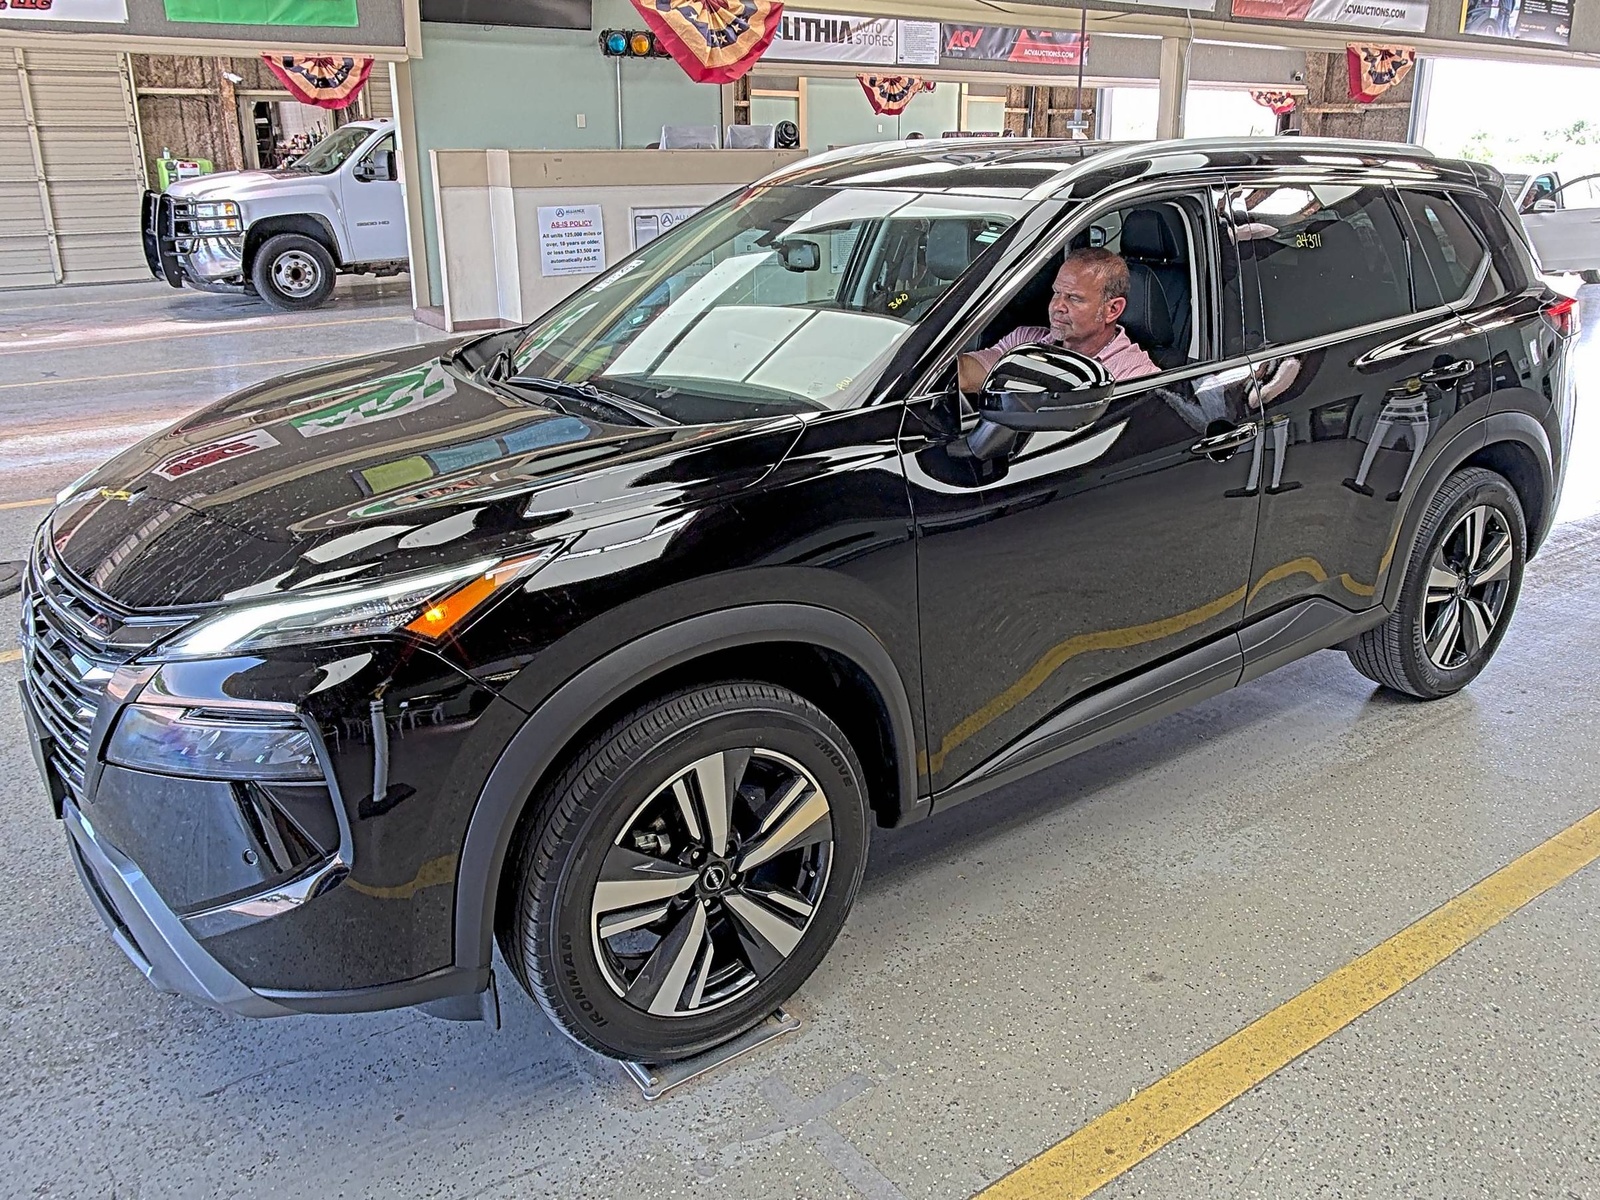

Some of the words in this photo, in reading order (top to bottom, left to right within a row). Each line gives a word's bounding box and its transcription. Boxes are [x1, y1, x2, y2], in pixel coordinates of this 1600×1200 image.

[783, 16, 853, 44] LITHIA
[856, 22, 882, 34] AUTO
[856, 34, 893, 47] STORES
[947, 28, 984, 50] ACV
[1024, 48, 1074, 58] ACVAUCTIONS.COM
[1296, 232, 1322, 249] 24371
[815, 740, 853, 787] iMOVE
[561, 933, 609, 1028] IRONMAN
